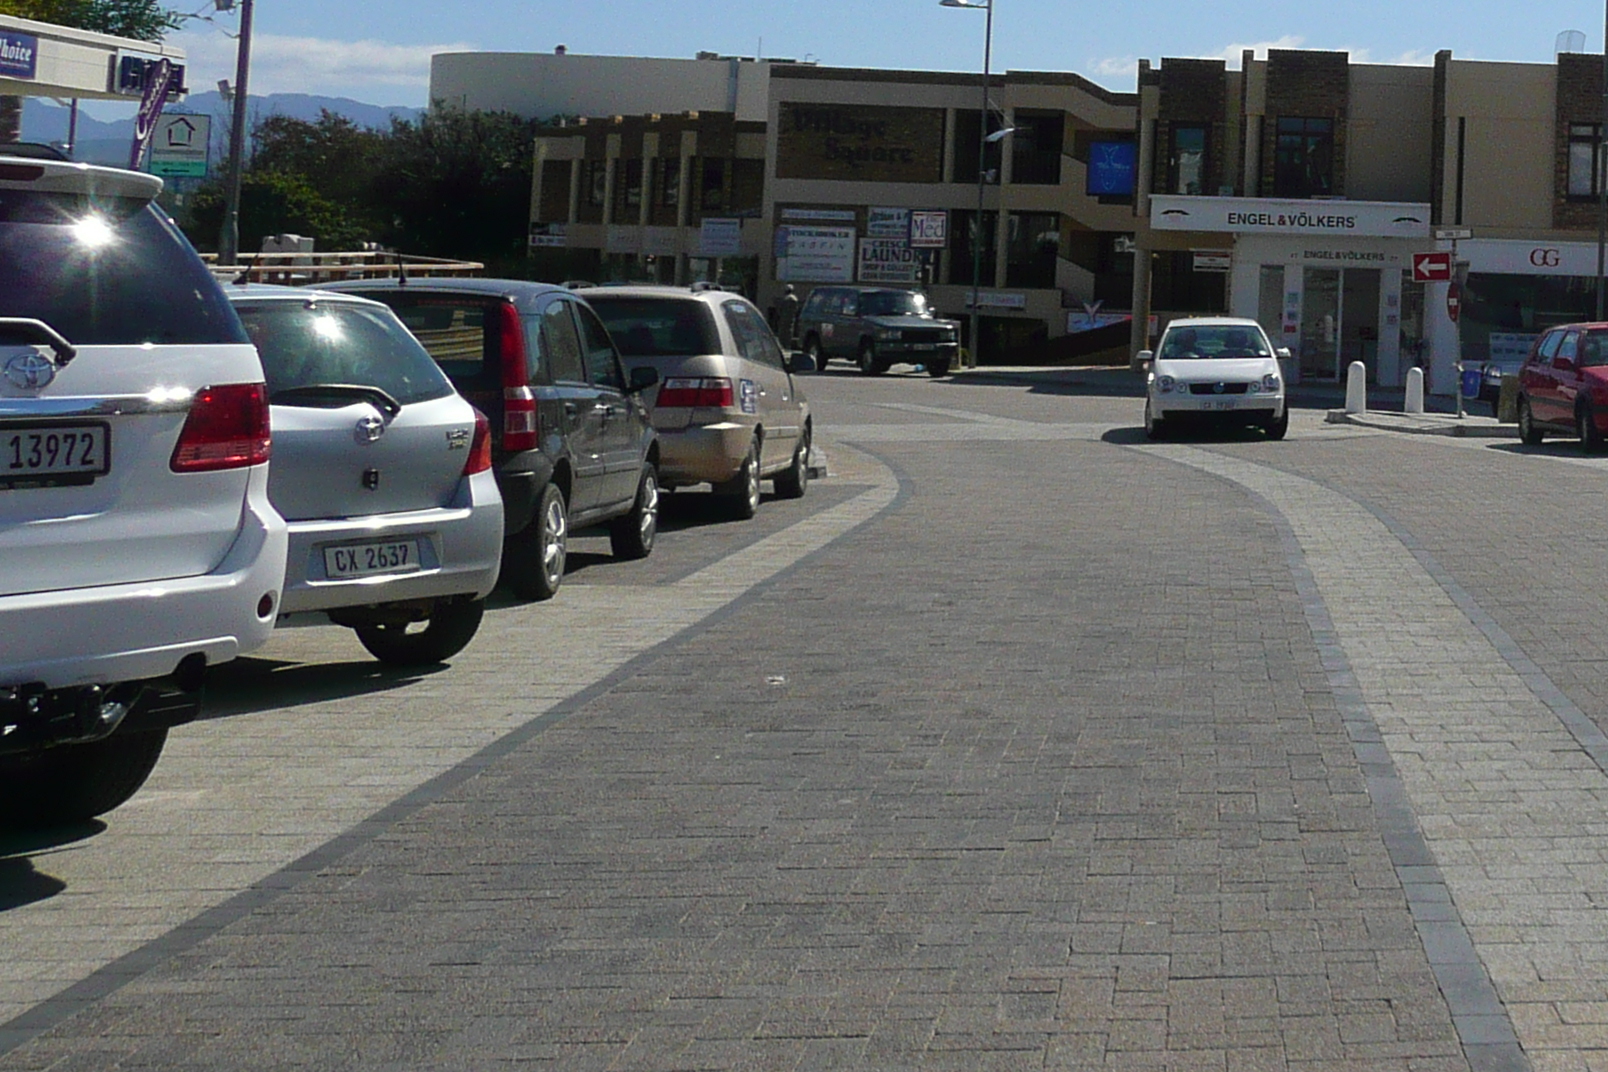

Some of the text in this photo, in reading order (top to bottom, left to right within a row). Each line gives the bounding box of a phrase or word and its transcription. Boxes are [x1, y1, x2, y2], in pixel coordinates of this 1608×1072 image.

[0, 38, 32, 62] hoice
[913, 218, 945, 238] Med
[1228, 213, 1275, 226] ENGEL
[1287, 212, 1356, 229] VÖLKERS
[863, 247, 924, 263] LAUNDR
[9, 432, 95, 469] 13972
[335, 544, 409, 573] CX 2637
